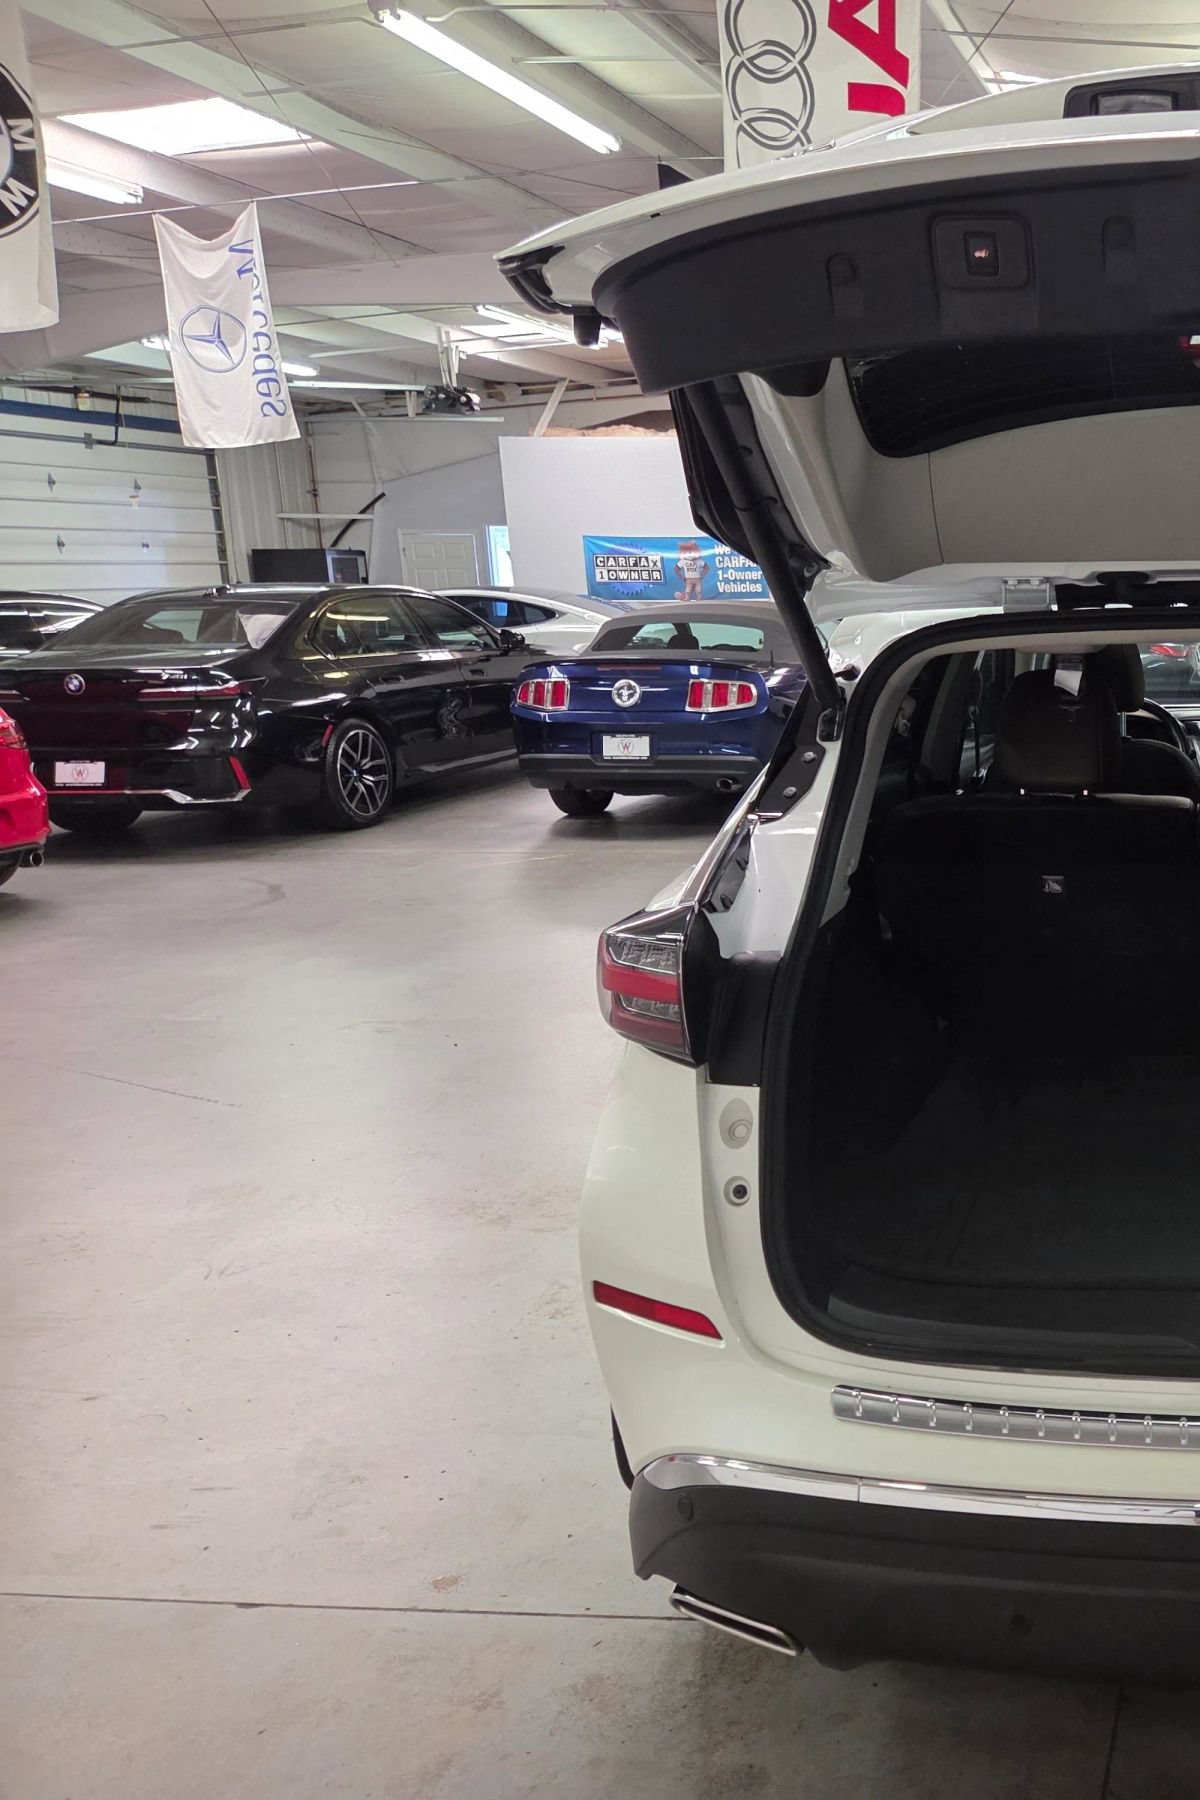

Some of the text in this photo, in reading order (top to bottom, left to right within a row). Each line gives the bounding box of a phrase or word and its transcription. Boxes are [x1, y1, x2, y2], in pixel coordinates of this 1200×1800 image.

[596, 556, 659, 568] CARFAX
[715, 556, 757, 568] CARFA
[608, 570, 661, 580] OWNER
[717, 569, 762, 581] 1-Owner
[717, 581, 763, 593] Vehicles
